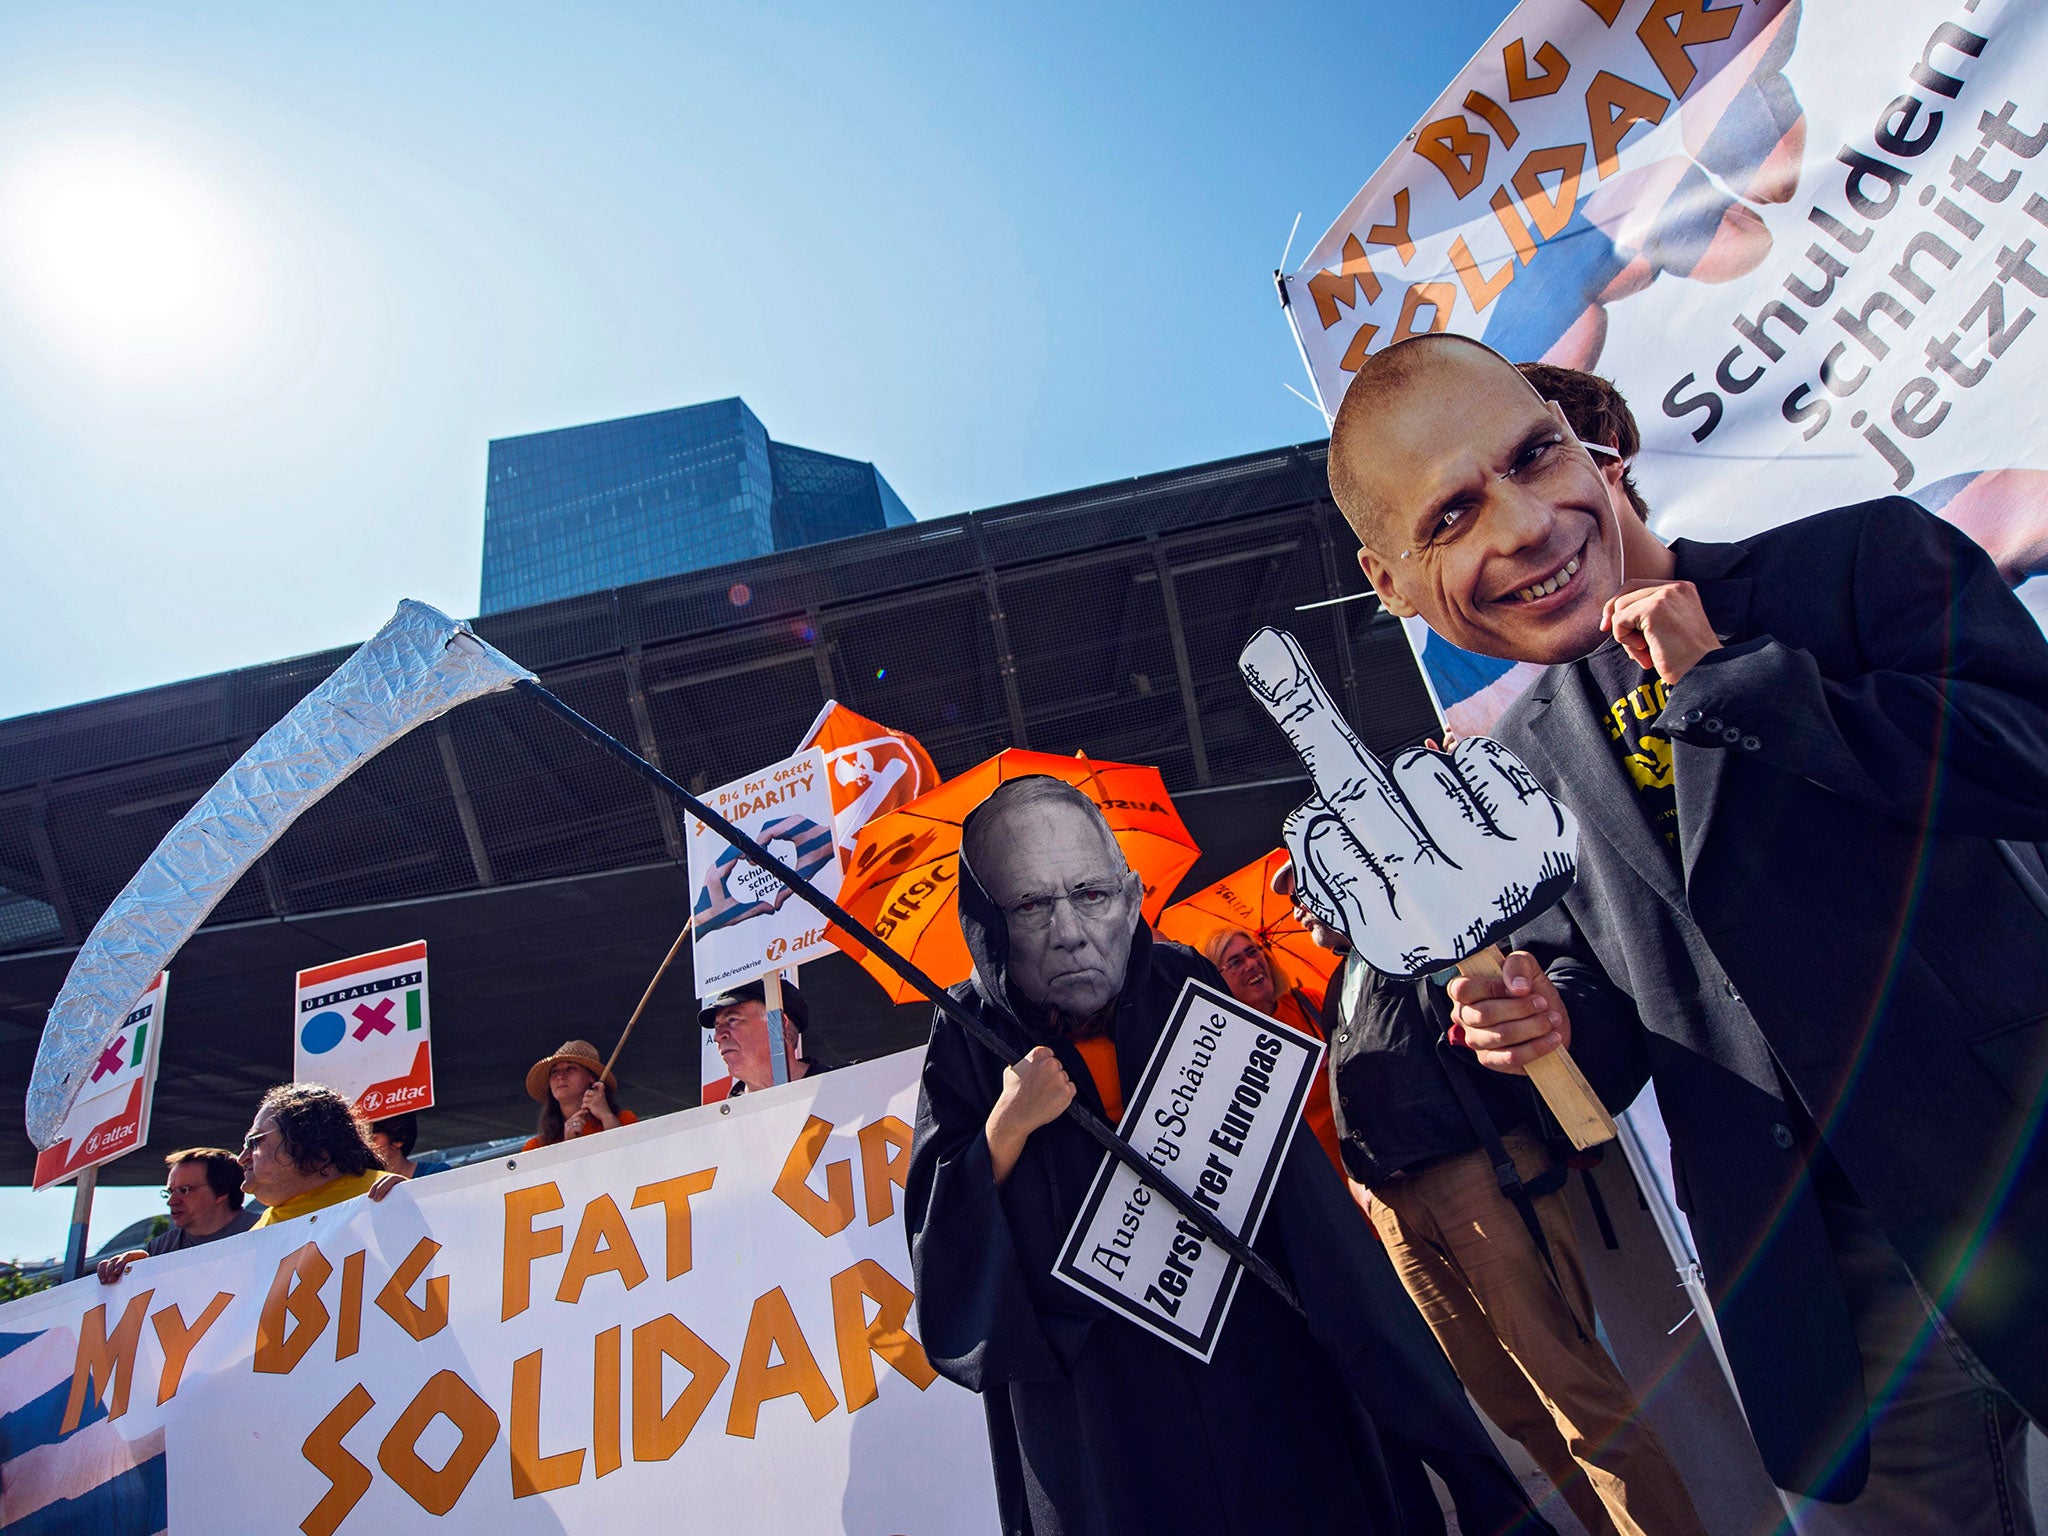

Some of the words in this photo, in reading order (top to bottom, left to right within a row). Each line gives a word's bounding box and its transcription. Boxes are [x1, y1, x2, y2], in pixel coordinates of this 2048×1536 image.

[1307, 188, 1415, 330] MY
[1412, 36, 1572, 200] BIG
[1340, 0, 1764, 372] SOLIDAR
[1783, 100, 2048, 441] schnitt
[696, 773, 815, 837] SLIDARITY
[719, 790, 739, 806] BIG
[744, 779, 766, 796] FAT
[773, 760, 813, 783] GREEK
[305, 983, 379, 1010] ÜBERALL
[392, 973, 418, 988] IST
[704, 959, 762, 985] attac.de/eurokrise
[128, 1008, 150, 1023] IST
[385, 1084, 428, 1105] attac
[101, 1121, 137, 1146] attac
[1091, 1012, 1227, 1282] Austerty-Schäuble
[1143, 1151, 1234, 1319] Zerstrer
[1208, 1032, 1283, 1157] Europas
[58, 1287, 235, 1436] MY
[252, 1235, 451, 1375] BIG
[500, 1166, 719, 1324] FAT
